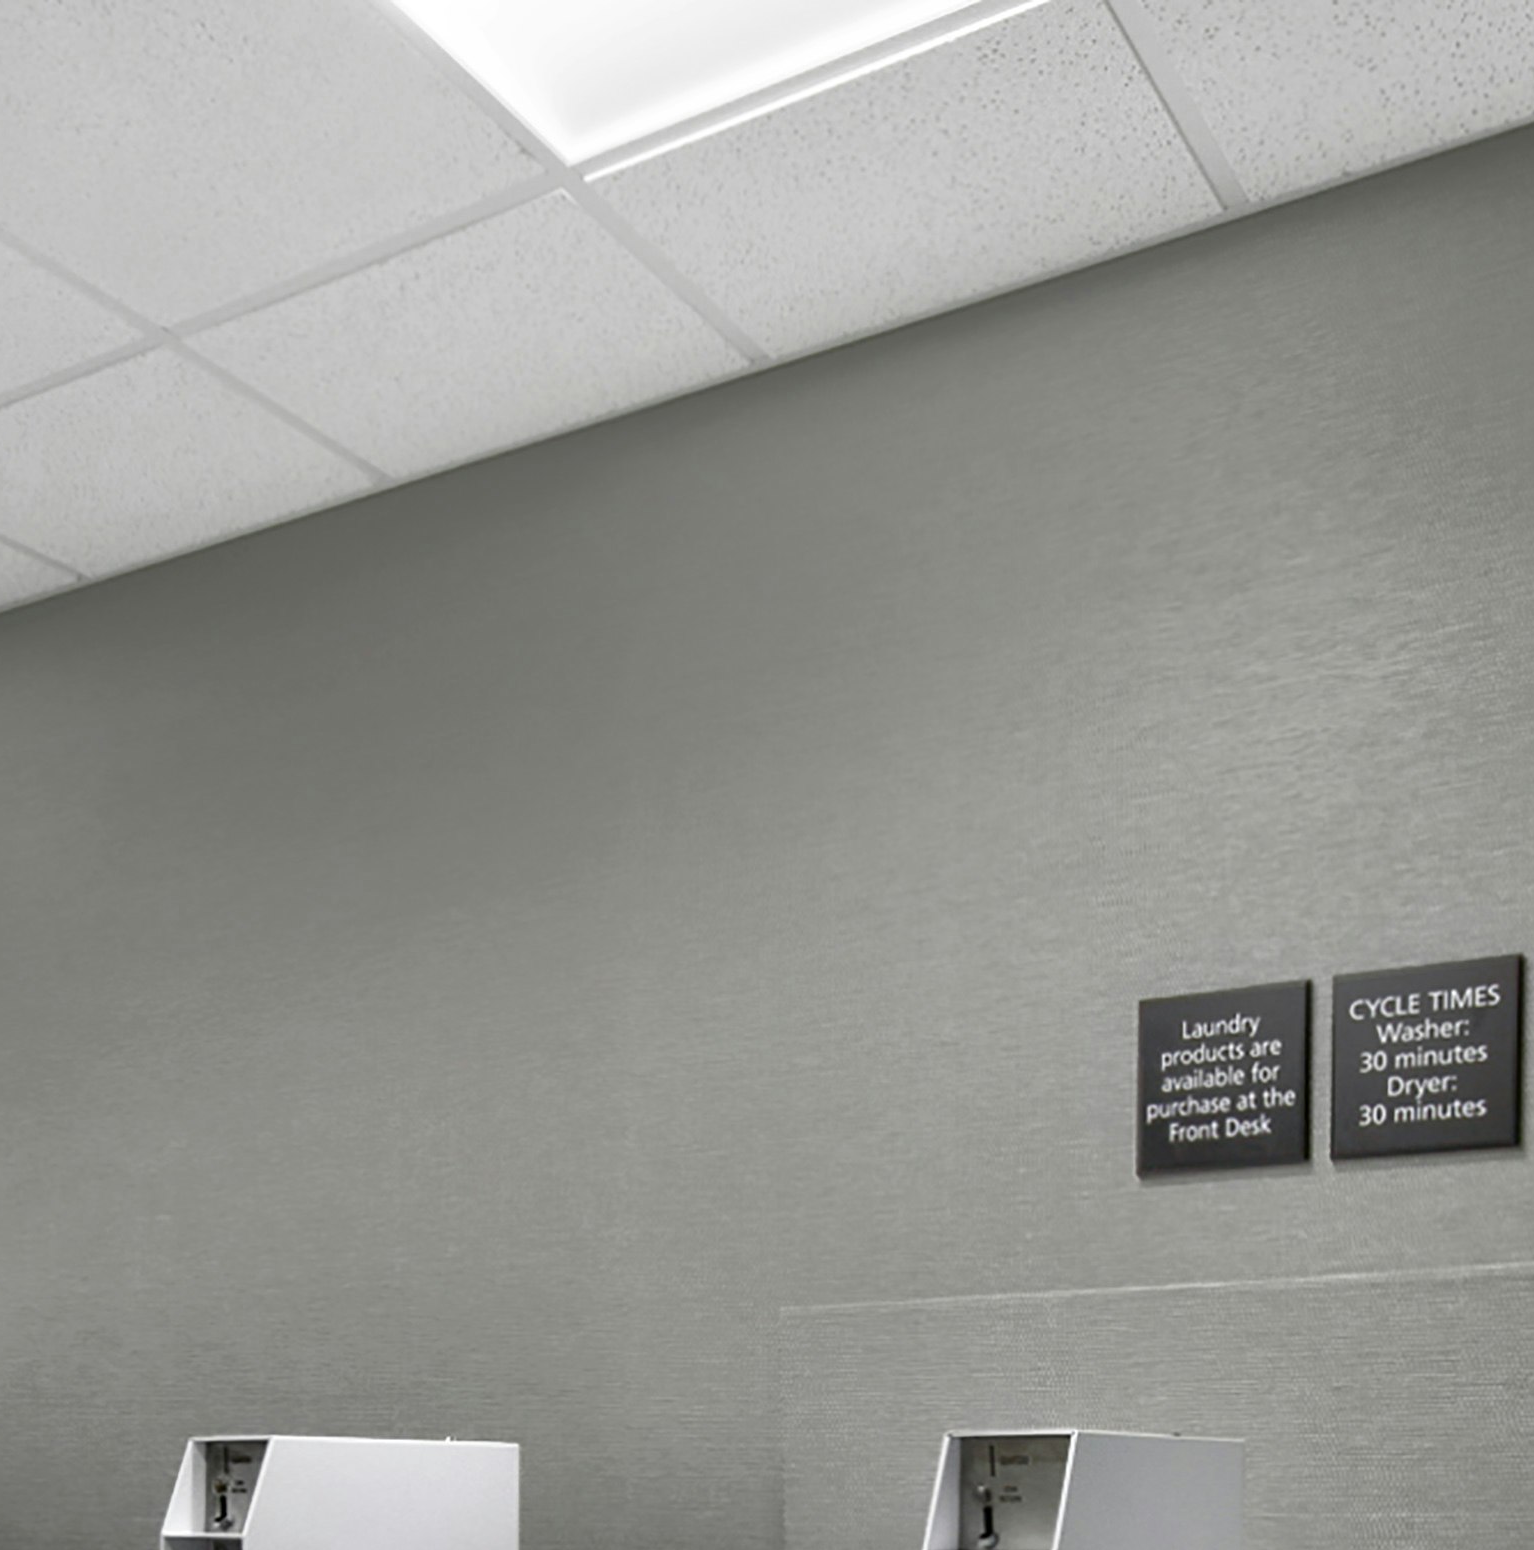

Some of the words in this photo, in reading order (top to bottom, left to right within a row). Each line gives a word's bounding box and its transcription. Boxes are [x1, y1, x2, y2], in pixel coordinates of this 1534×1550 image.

[1349, 993, 1420, 1021] CYCLE
[1428, 984, 1501, 1011] TIMES
[1182, 1013, 1261, 1040] Laundry
[1376, 1018, 1470, 1044] Washer:
[1161, 1043, 1245, 1072] products
[1249, 1039, 1282, 1057] are
[1359, 1050, 1388, 1074] 30
[1395, 1045, 1489, 1069] minutes
[1161, 1065, 1245, 1093] available
[1251, 1061, 1280, 1083] for
[1387, 1075, 1458, 1099] Dryer:
[1146, 1095, 1231, 1124] purchase
[1236, 1091, 1257, 1112] at
[1263, 1086, 1296, 1107] the
[1359, 1104, 1387, 1127] 30
[1394, 1099, 1488, 1123] minutes
[1169, 1121, 1219, 1143] Front
[1225, 1114, 1272, 1138] Desk
